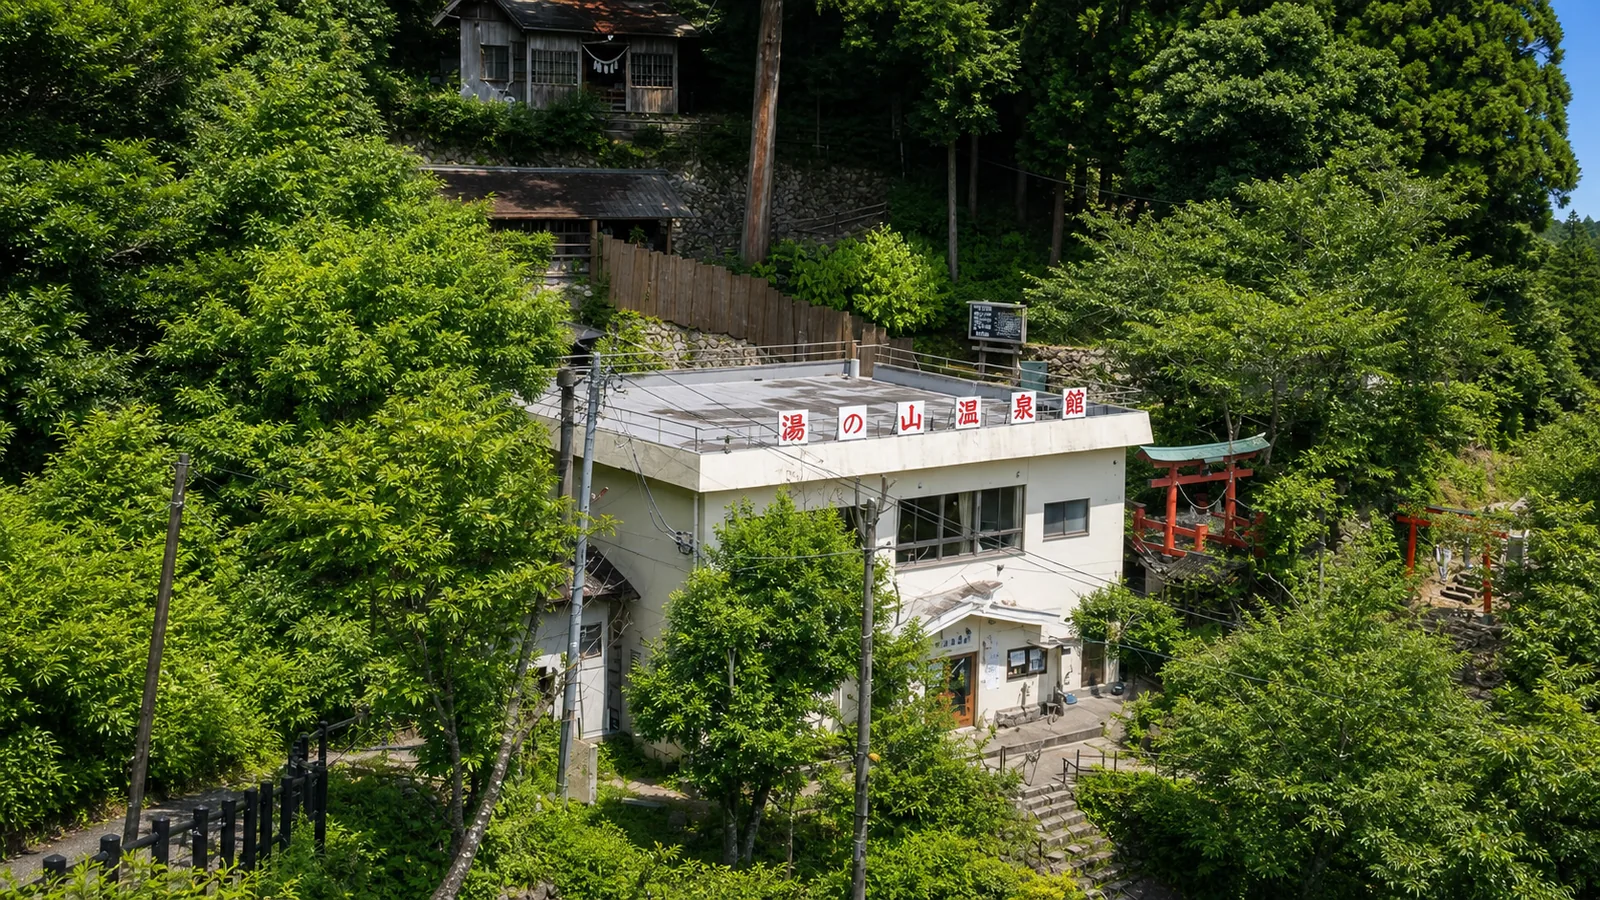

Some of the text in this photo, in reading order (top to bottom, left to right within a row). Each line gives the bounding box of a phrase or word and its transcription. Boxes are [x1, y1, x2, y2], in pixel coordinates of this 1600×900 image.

[782, 389, 1085, 440] 湯の山温泉館
